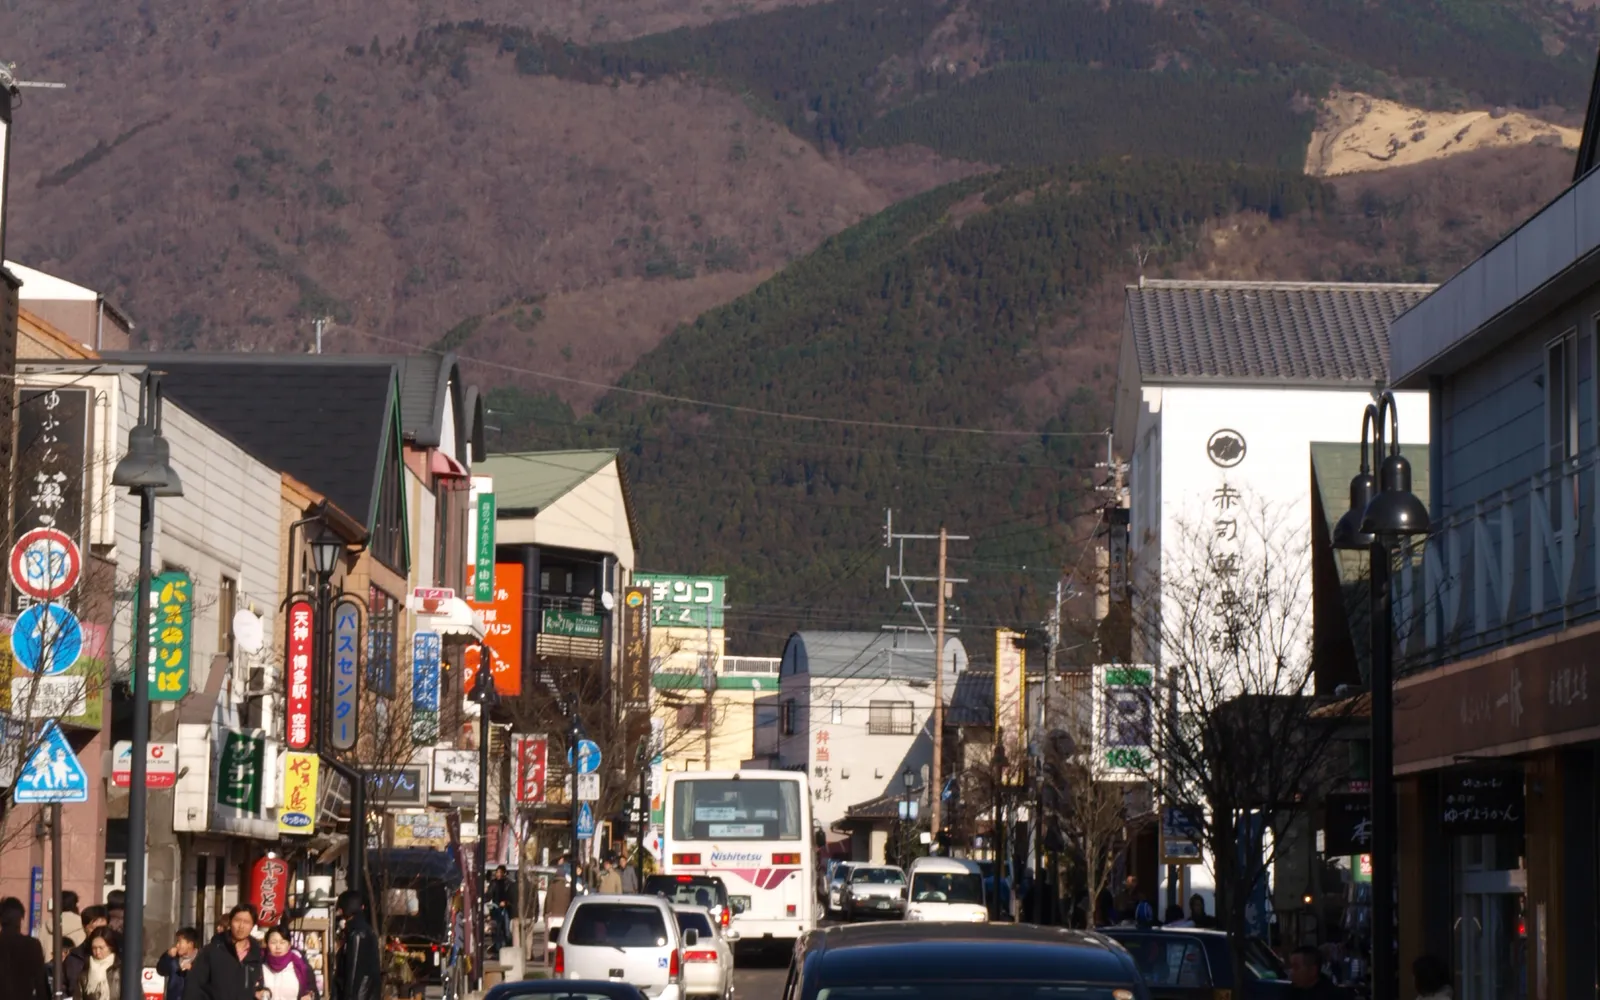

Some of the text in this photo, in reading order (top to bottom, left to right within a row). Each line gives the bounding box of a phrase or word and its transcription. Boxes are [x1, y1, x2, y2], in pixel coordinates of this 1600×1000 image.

[42, 390, 60, 464] ゆふいん
[27, 550, 65, 580] 30
[157, 581, 187, 691] バスのりば
[291, 611, 309, 744] 天神・博多駅・空港
[336, 613, 356, 741] バスセンター
[816, 730, 829, 761] 弁当
[286, 758, 312, 811] やき鳥
[710, 851, 762, 862] Nishitetsu
[260, 861, 284, 922] やきとり
